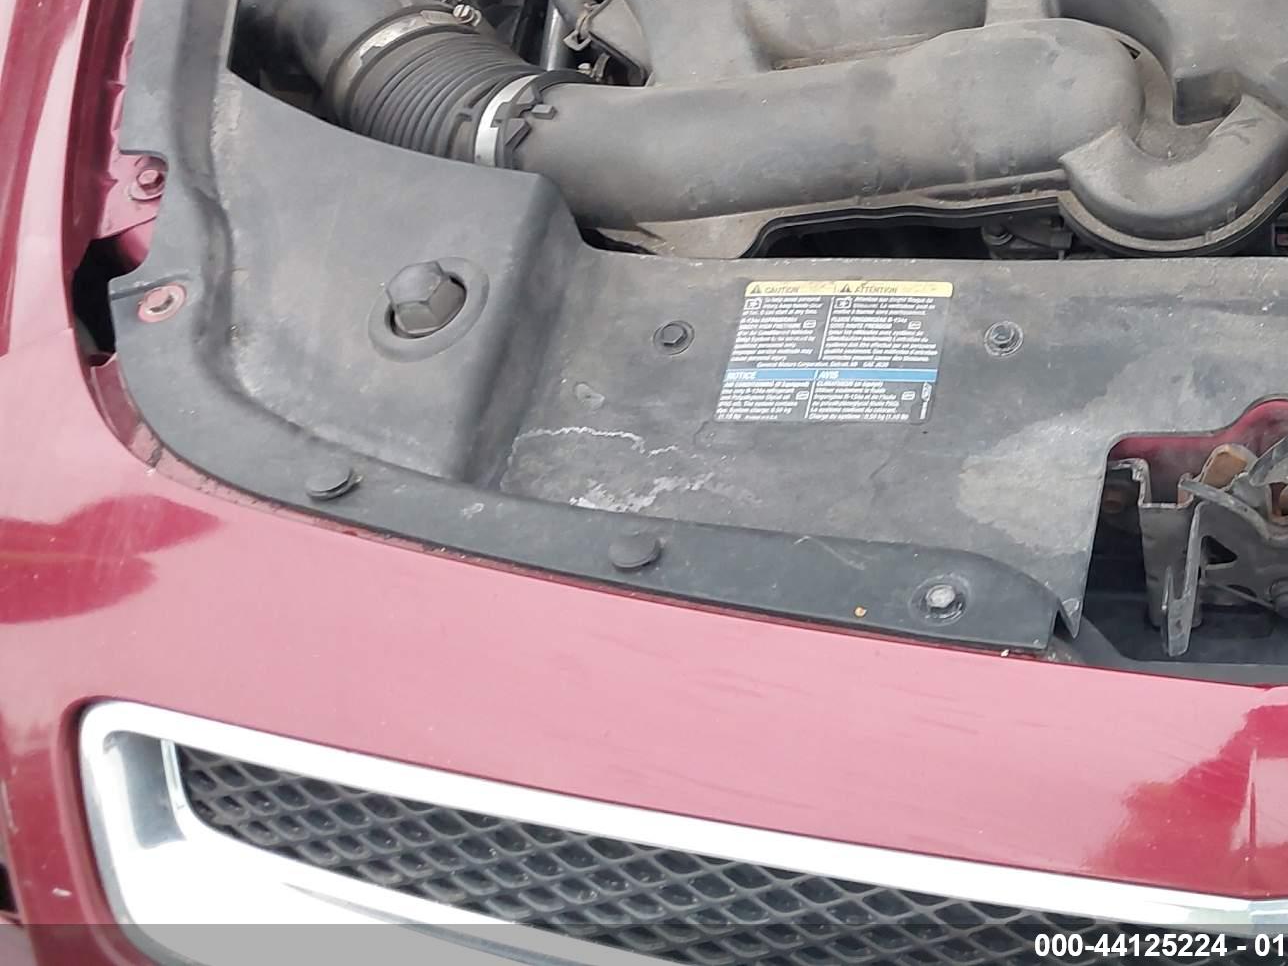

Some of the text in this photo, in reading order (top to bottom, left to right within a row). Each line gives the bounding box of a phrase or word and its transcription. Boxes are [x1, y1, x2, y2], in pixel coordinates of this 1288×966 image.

[764, 286, 801, 294] CAUTION
[854, 286, 898, 294] ATTENTION
[818, 371, 839, 380] AVIS
